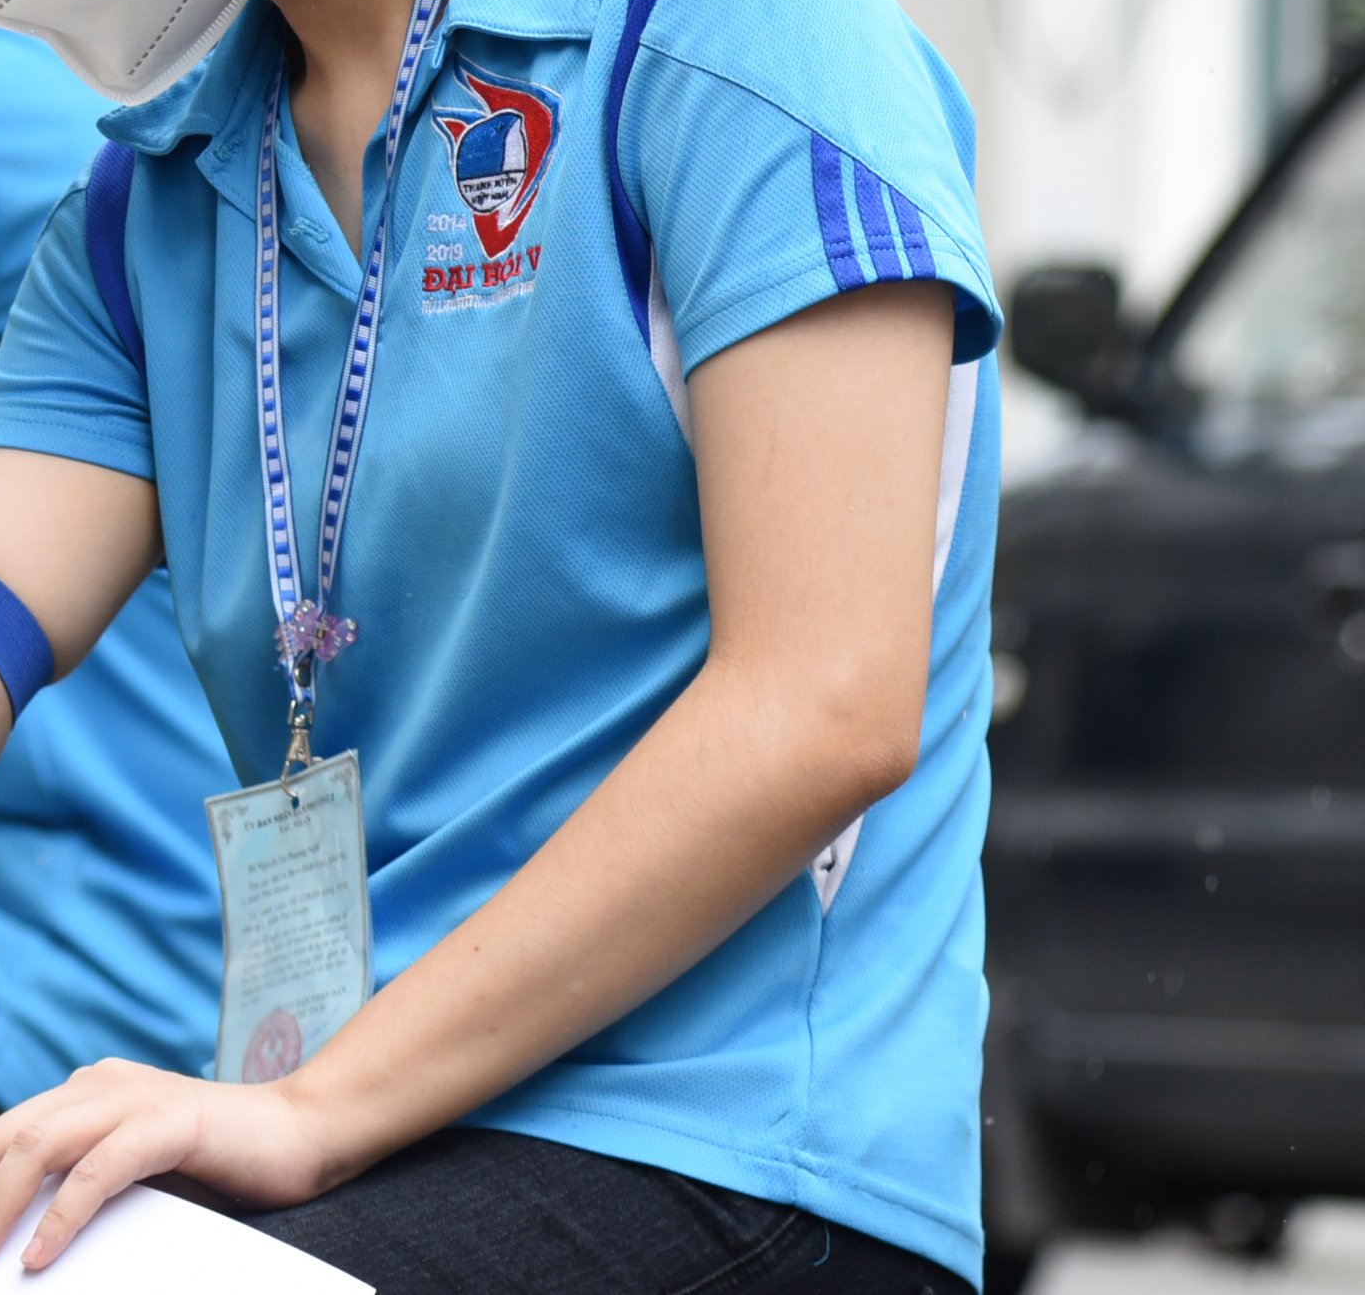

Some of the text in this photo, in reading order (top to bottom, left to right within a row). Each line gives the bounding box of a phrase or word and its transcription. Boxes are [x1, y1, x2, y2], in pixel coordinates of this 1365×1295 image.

[427, 214, 467, 232] 2014
[425, 244, 463, 262] 2019
[422, 265, 475, 296] ĐẠI
